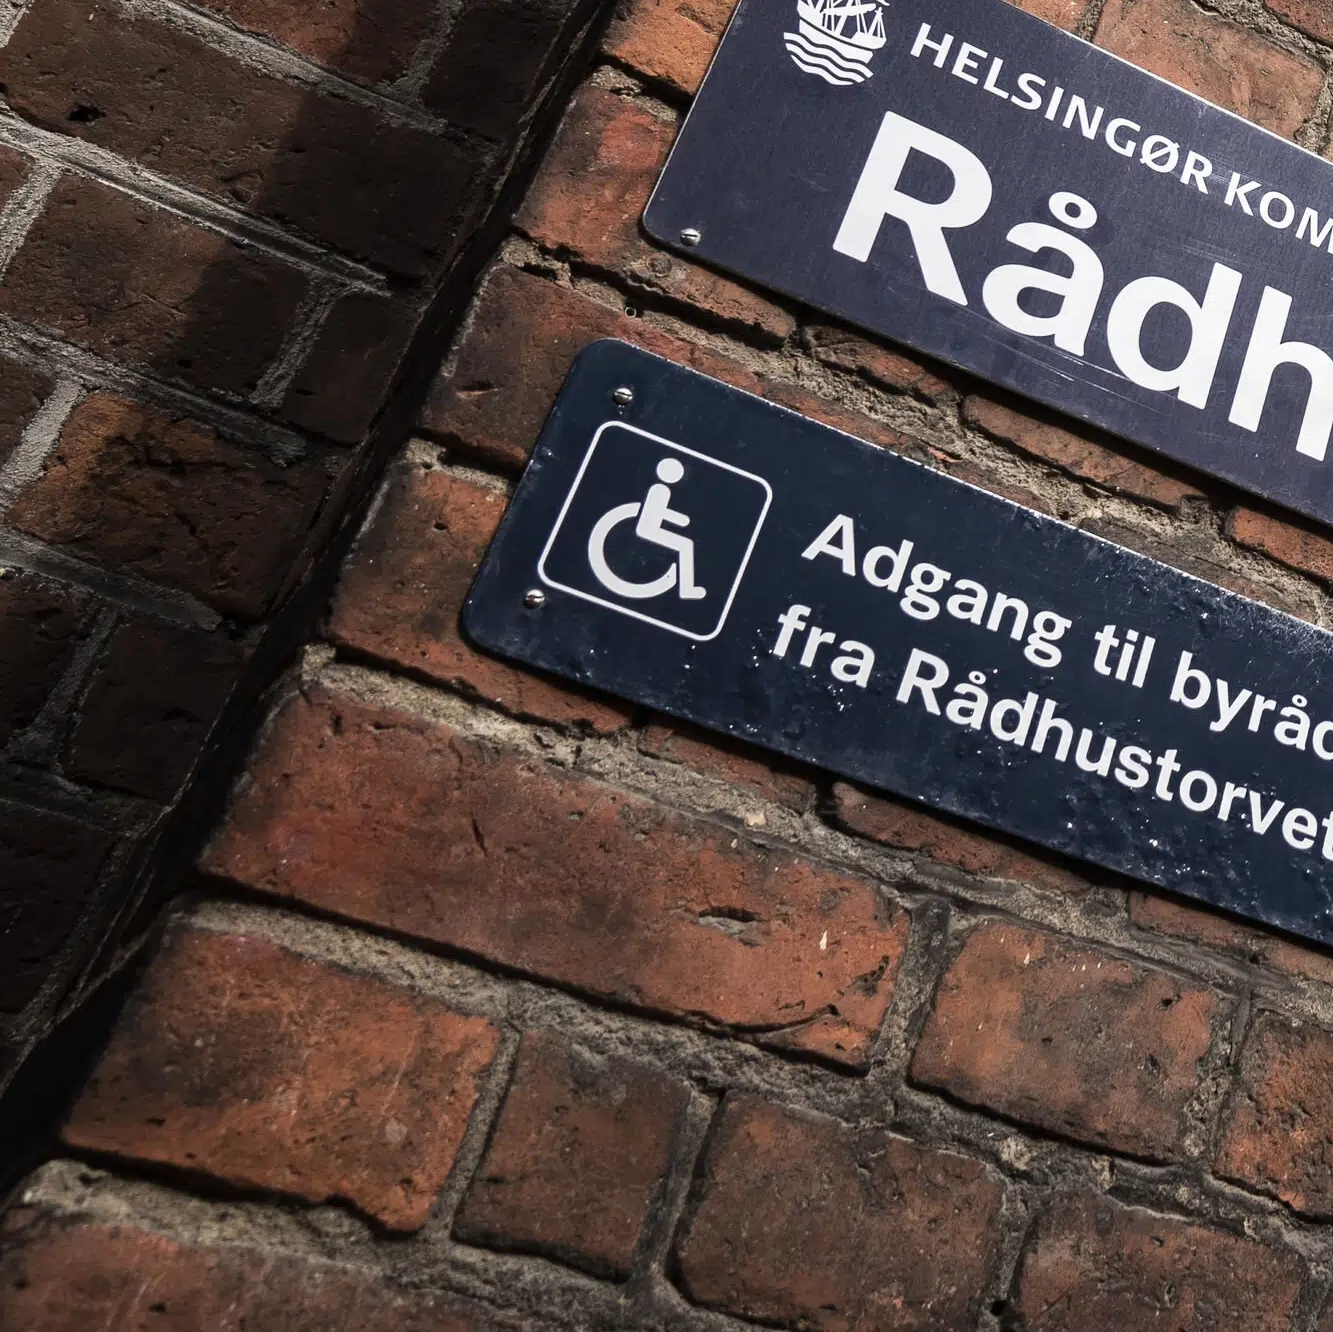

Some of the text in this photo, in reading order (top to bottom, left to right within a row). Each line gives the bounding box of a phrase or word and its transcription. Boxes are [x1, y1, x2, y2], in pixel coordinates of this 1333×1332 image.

[909, 21, 1214, 196] HELSINGØR
[772, 603, 876, 689] fra
[800, 513, 1074, 669] Adgang
[1092, 623, 1157, 689] til
